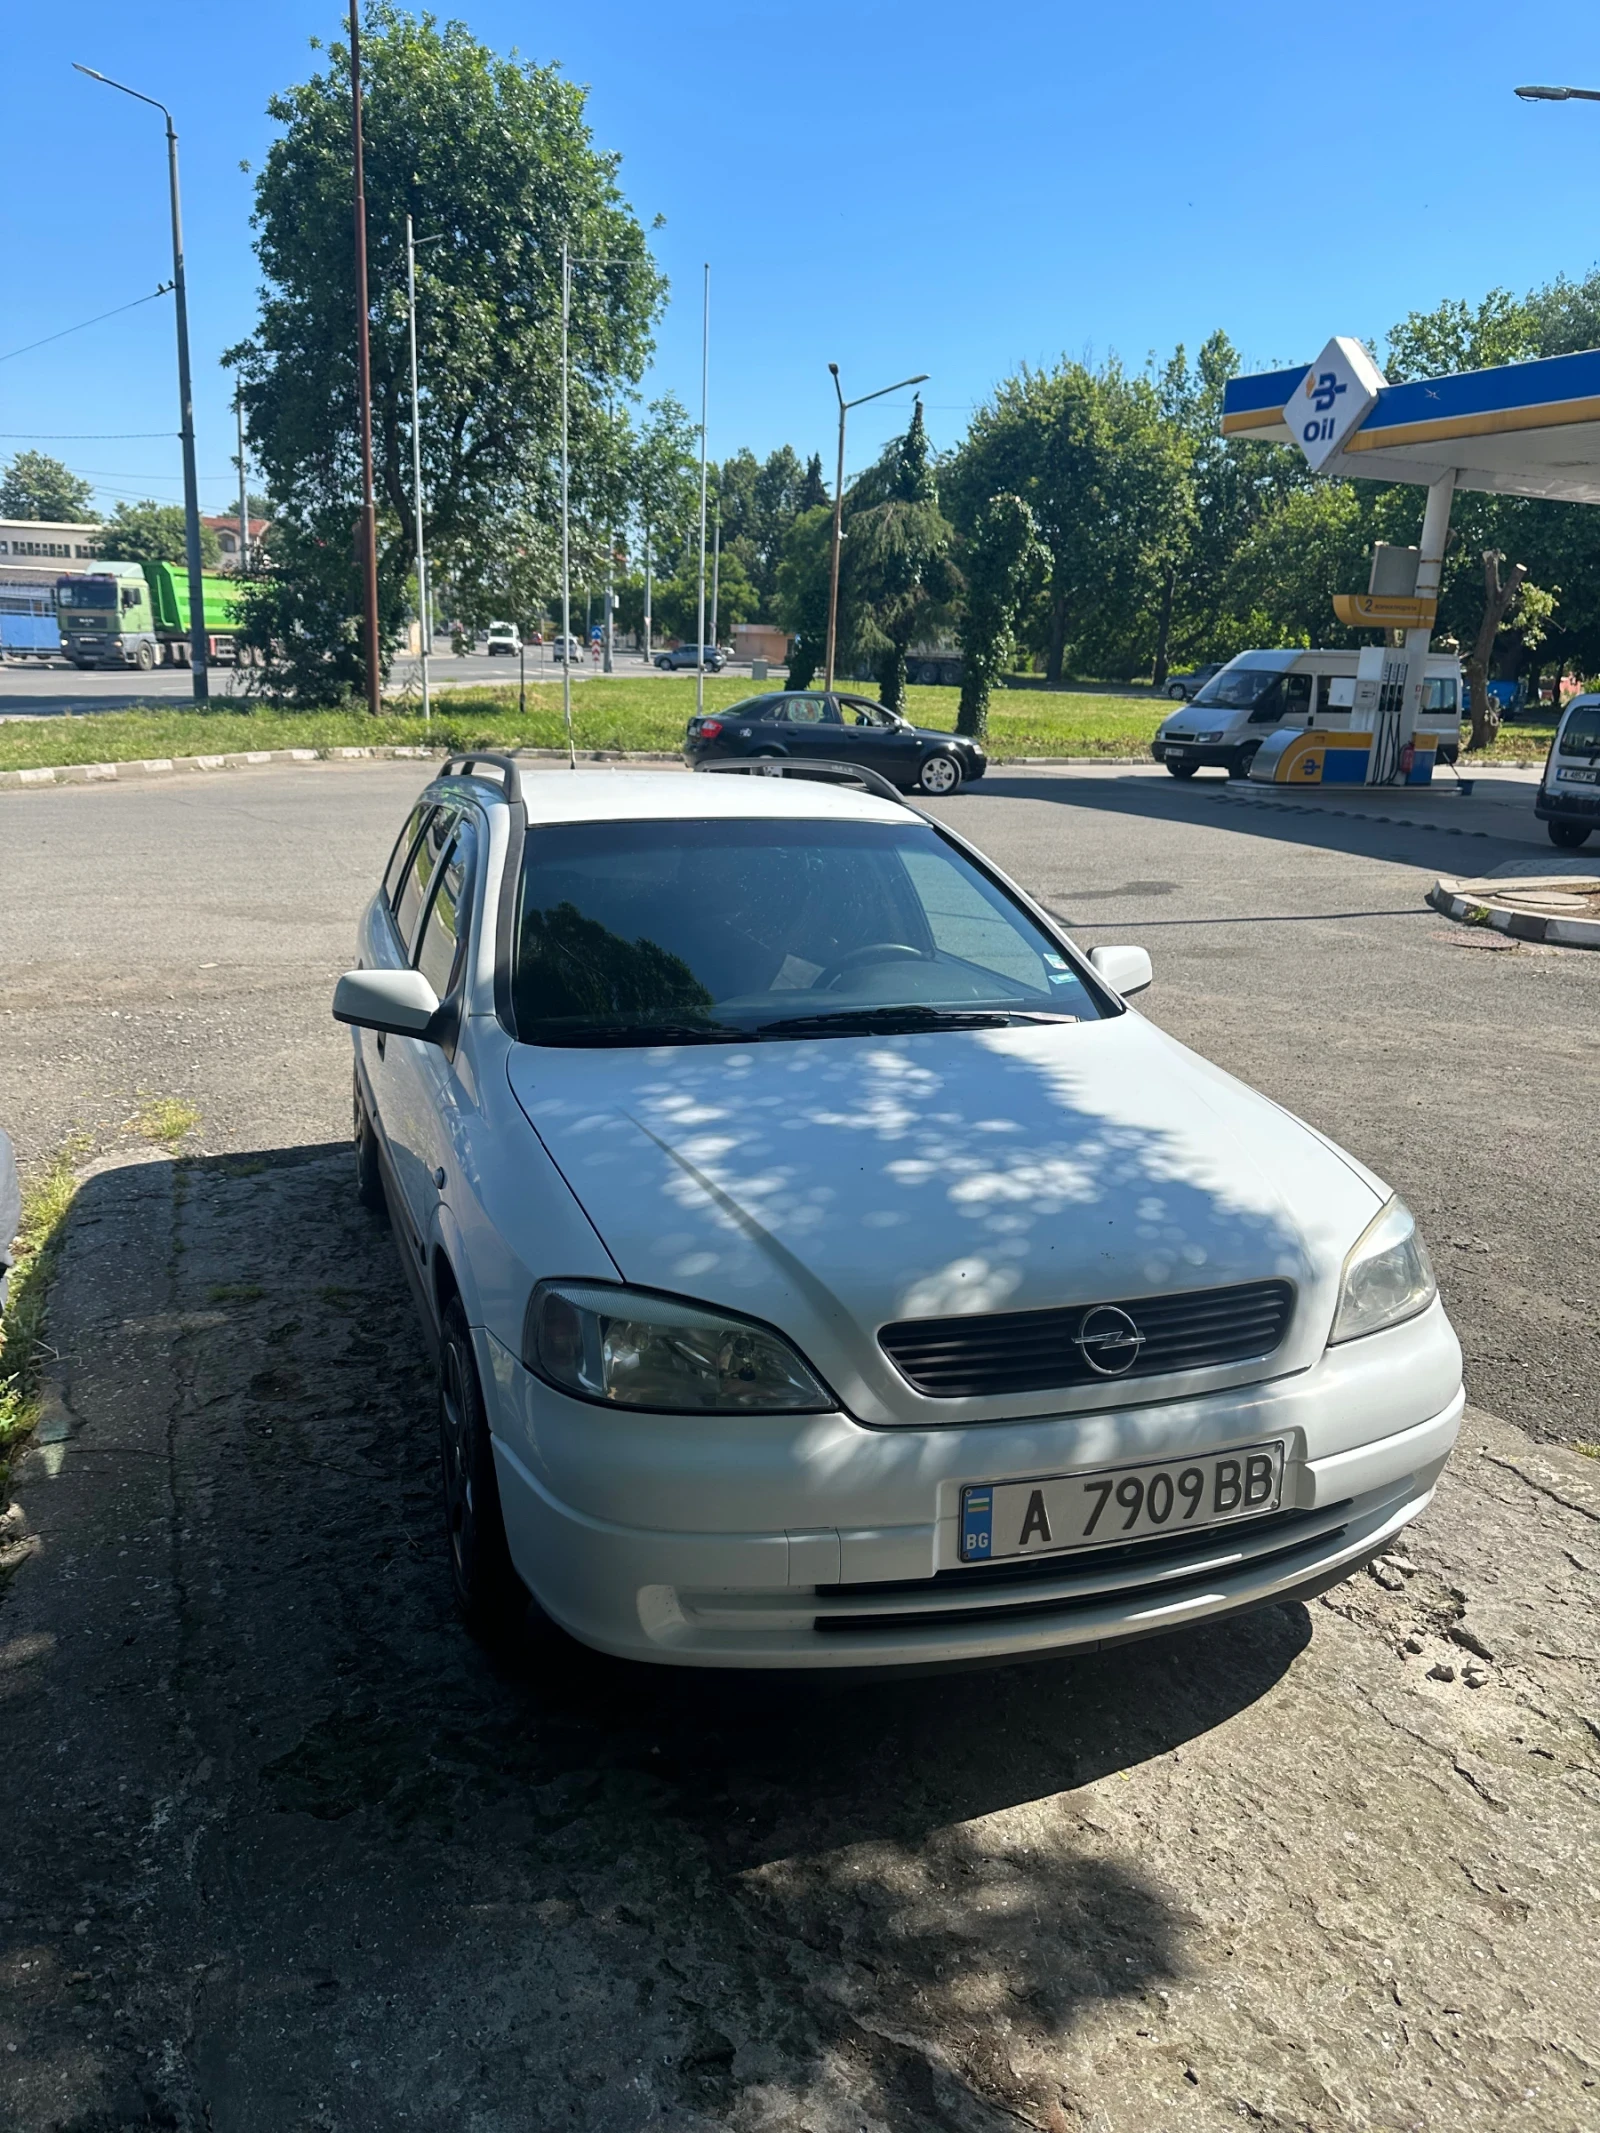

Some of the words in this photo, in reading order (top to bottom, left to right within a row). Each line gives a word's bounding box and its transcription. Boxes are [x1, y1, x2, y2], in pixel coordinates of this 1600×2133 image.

[1364, 598, 1373, 612] 2
[1019, 1489, 1052, 1545] A
[1083, 1467, 1204, 1536] 7909
[1214, 1453, 1274, 1513] BB
[966, 1533, 988, 1549] BG
